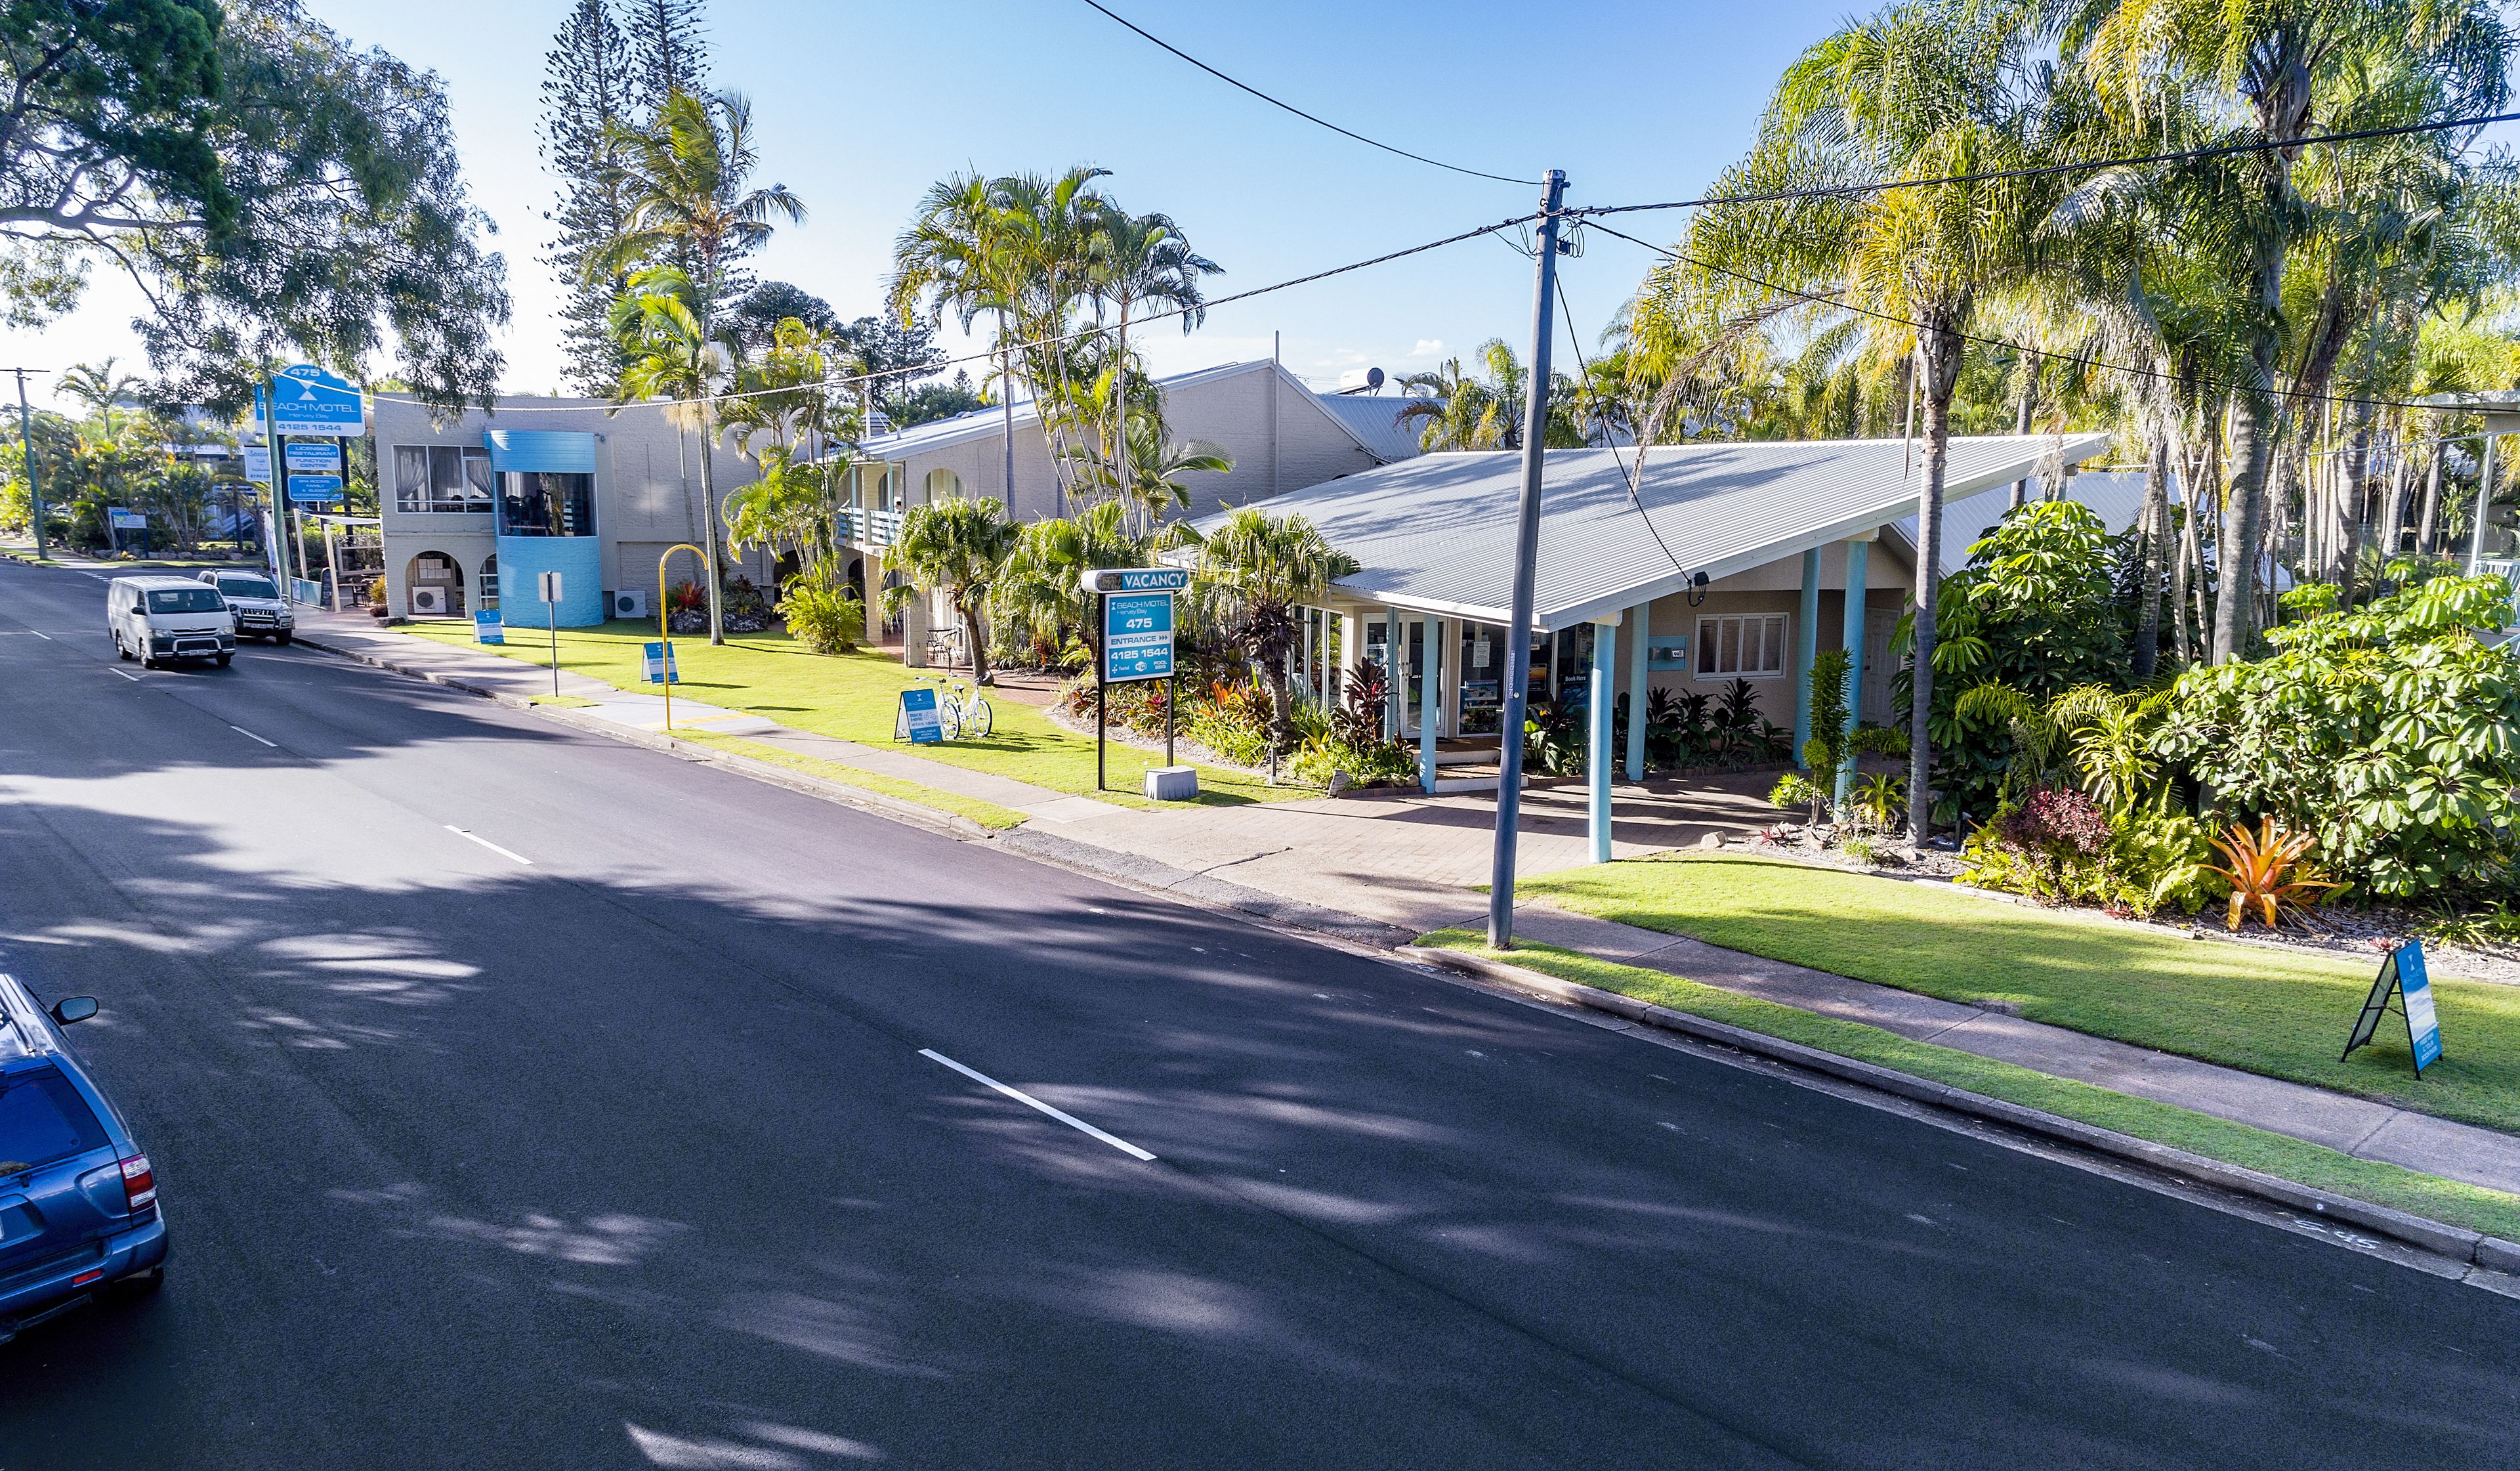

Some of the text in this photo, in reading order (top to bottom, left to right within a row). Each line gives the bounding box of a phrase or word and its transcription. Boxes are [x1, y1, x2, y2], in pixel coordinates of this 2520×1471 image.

[291, 368, 320, 377] 475
[309, 404, 358, 413] MOTEL
[1124, 572, 1185, 588] VACANCY
[1117, 601, 1143, 609] BEACH
[1126, 618, 1152, 629] 475
[1111, 635, 1156, 645] ENTRANCE
[1110, 647, 1168, 660] 4125 1544
